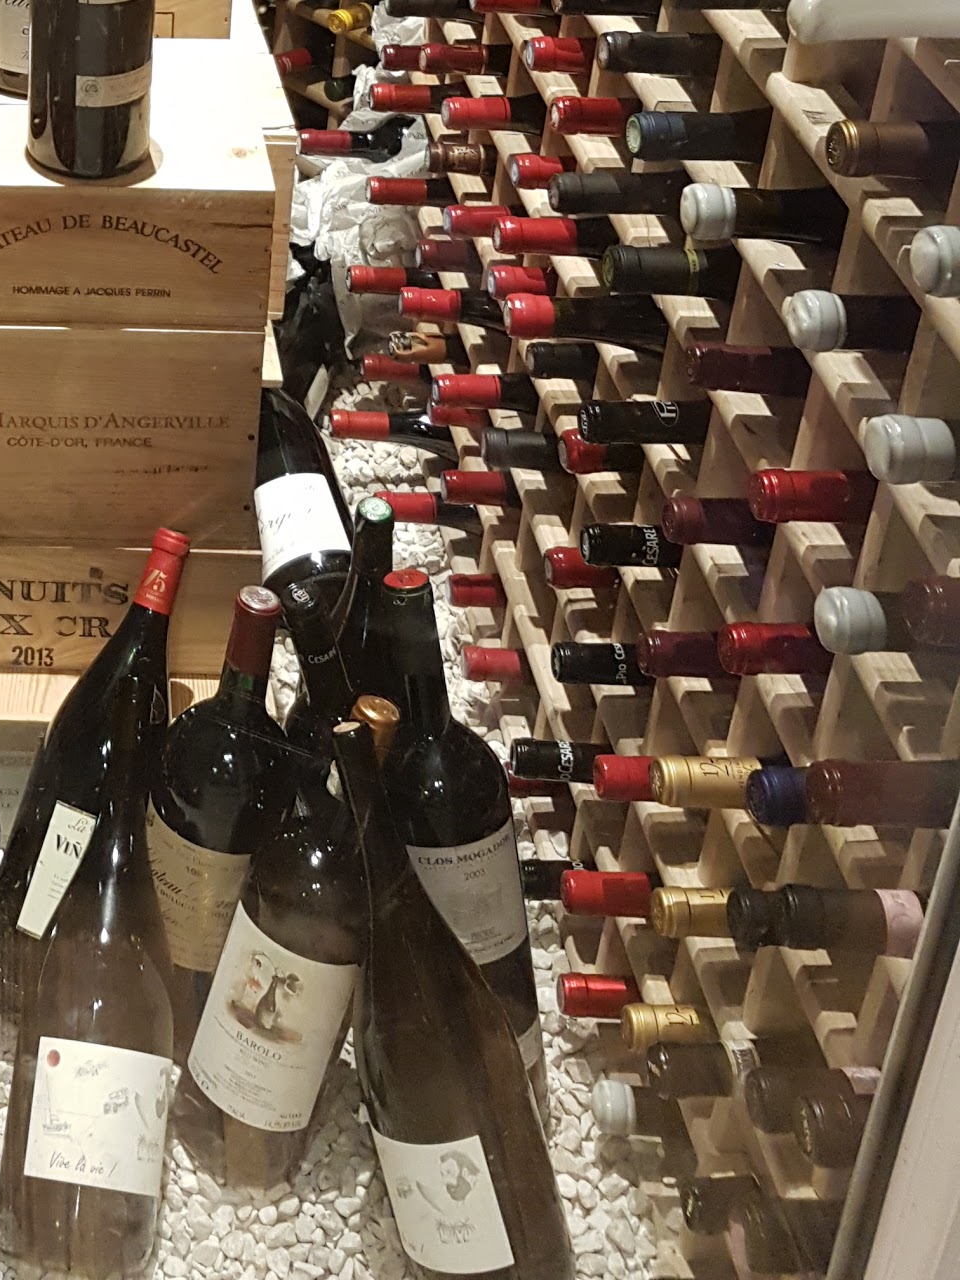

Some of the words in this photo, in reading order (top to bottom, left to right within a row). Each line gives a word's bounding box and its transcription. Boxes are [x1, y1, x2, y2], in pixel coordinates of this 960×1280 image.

[61, 214, 92, 231] DE
[100, 214, 224, 275] BEAUCASTEL
[12, 285, 70, 296] HOMMAGE
[84, 287, 131, 297] JACQUES
[135, 287, 172, 298] PERRIN
[95, 436, 154, 449] FRANCE
[54, 615, 114, 639] CR
[11, 645, 55, 667] 2013
[418, 856, 453, 866] CLOS
[456, 832, 511, 864] MOGADOR
[236, 1030, 282, 1061] BAROLO
[48, 1151, 71, 1169] Vive
[75, 1154, 87, 1172] la
[90, 1161, 104, 1176] vie
